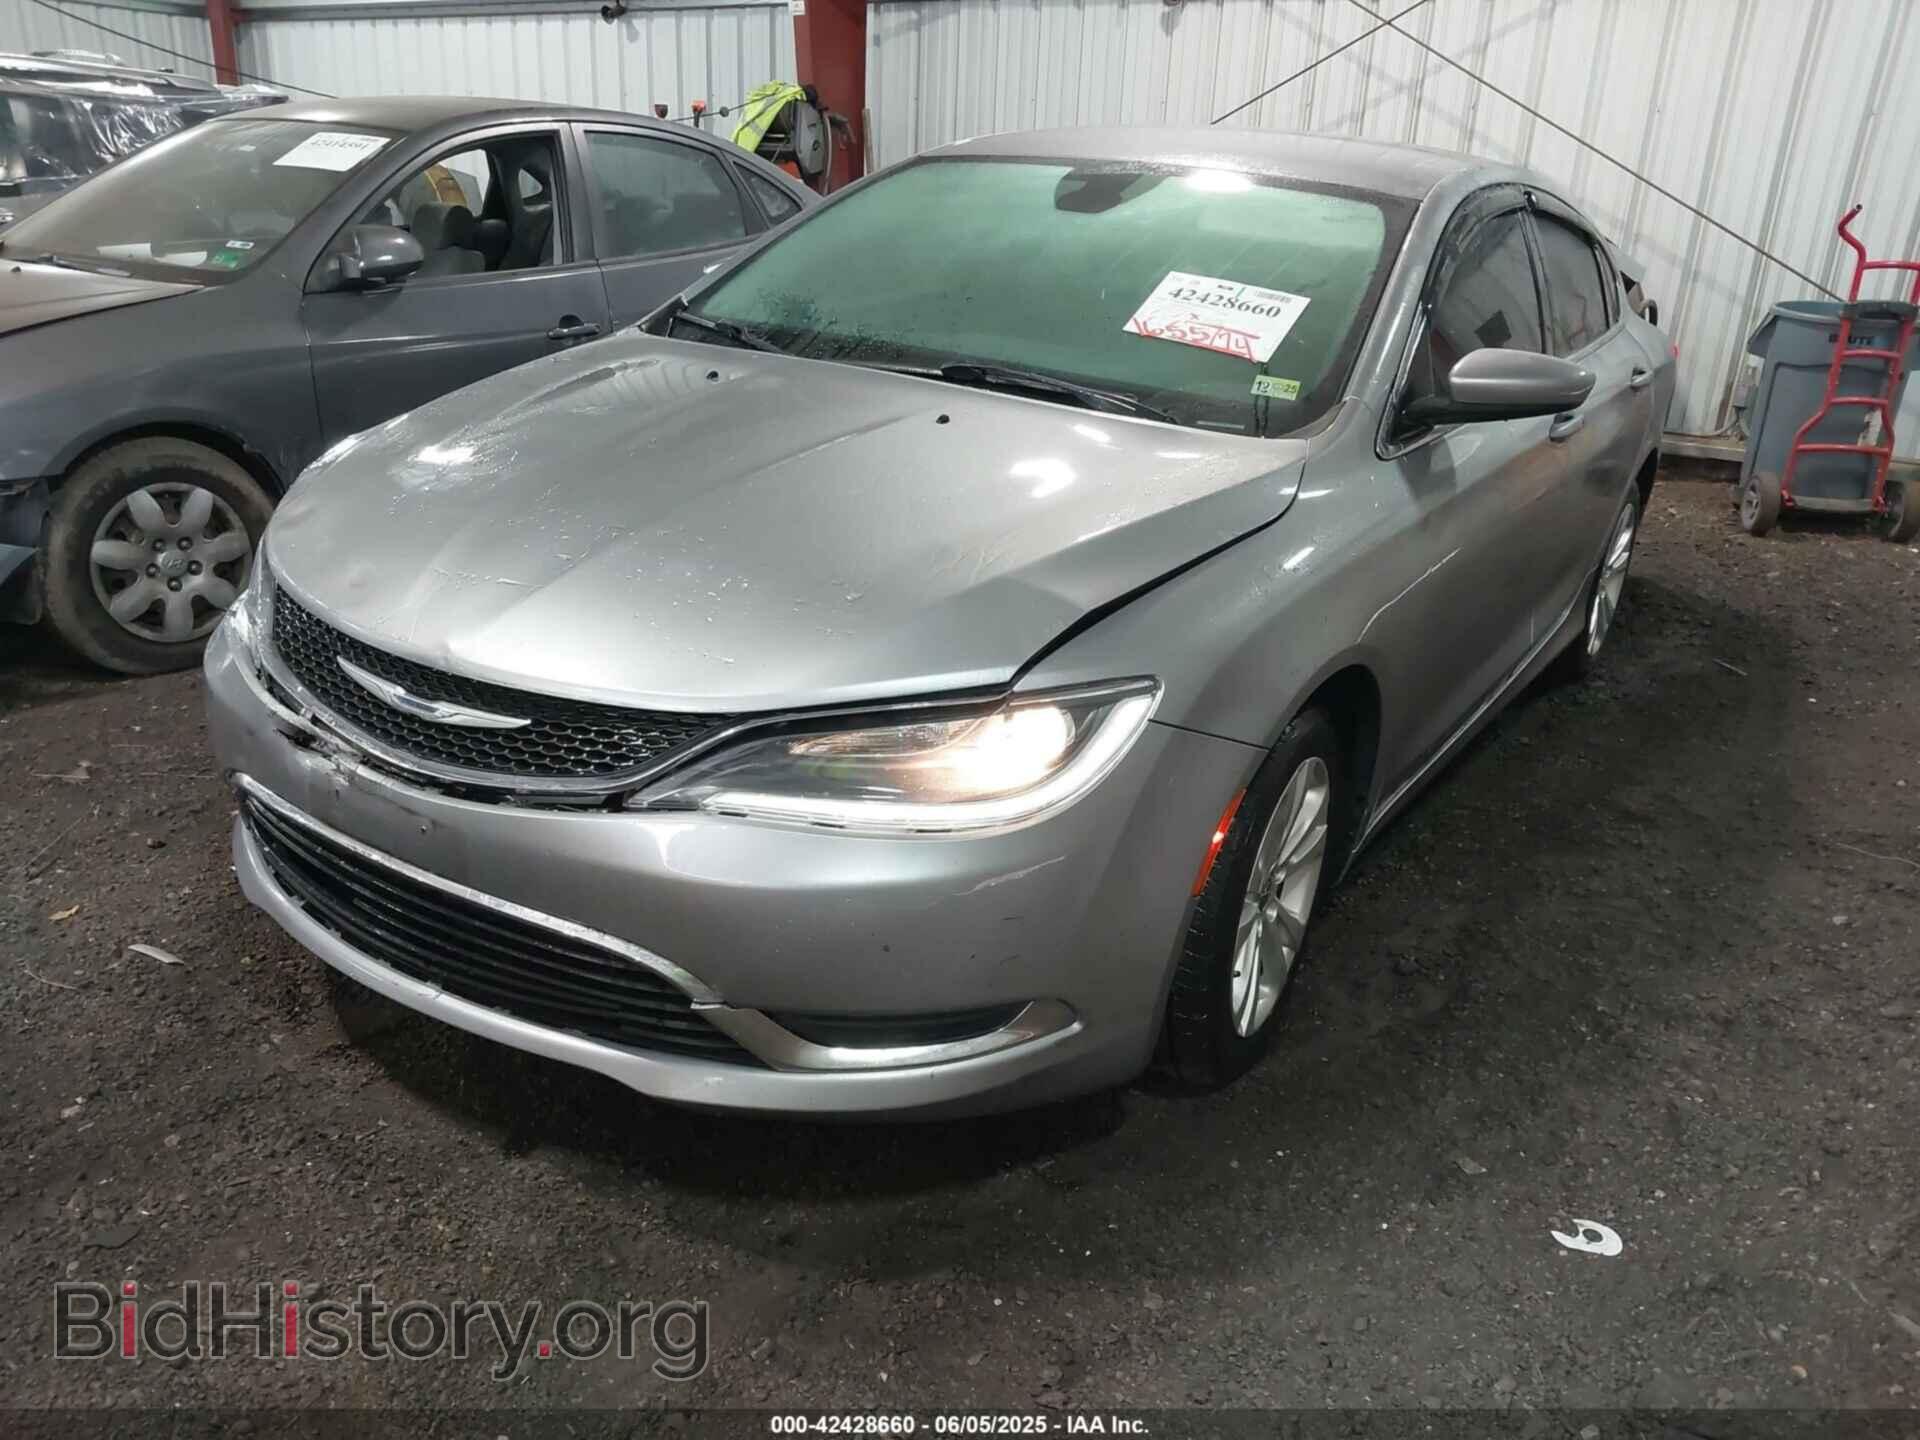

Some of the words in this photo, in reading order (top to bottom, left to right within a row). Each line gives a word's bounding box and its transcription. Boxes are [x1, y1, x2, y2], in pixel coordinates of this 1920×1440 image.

[1168, 286, 1281, 318] 42428660
[1828, 334, 1874, 346] BUTE
[1256, 380, 1271, 393] 12
